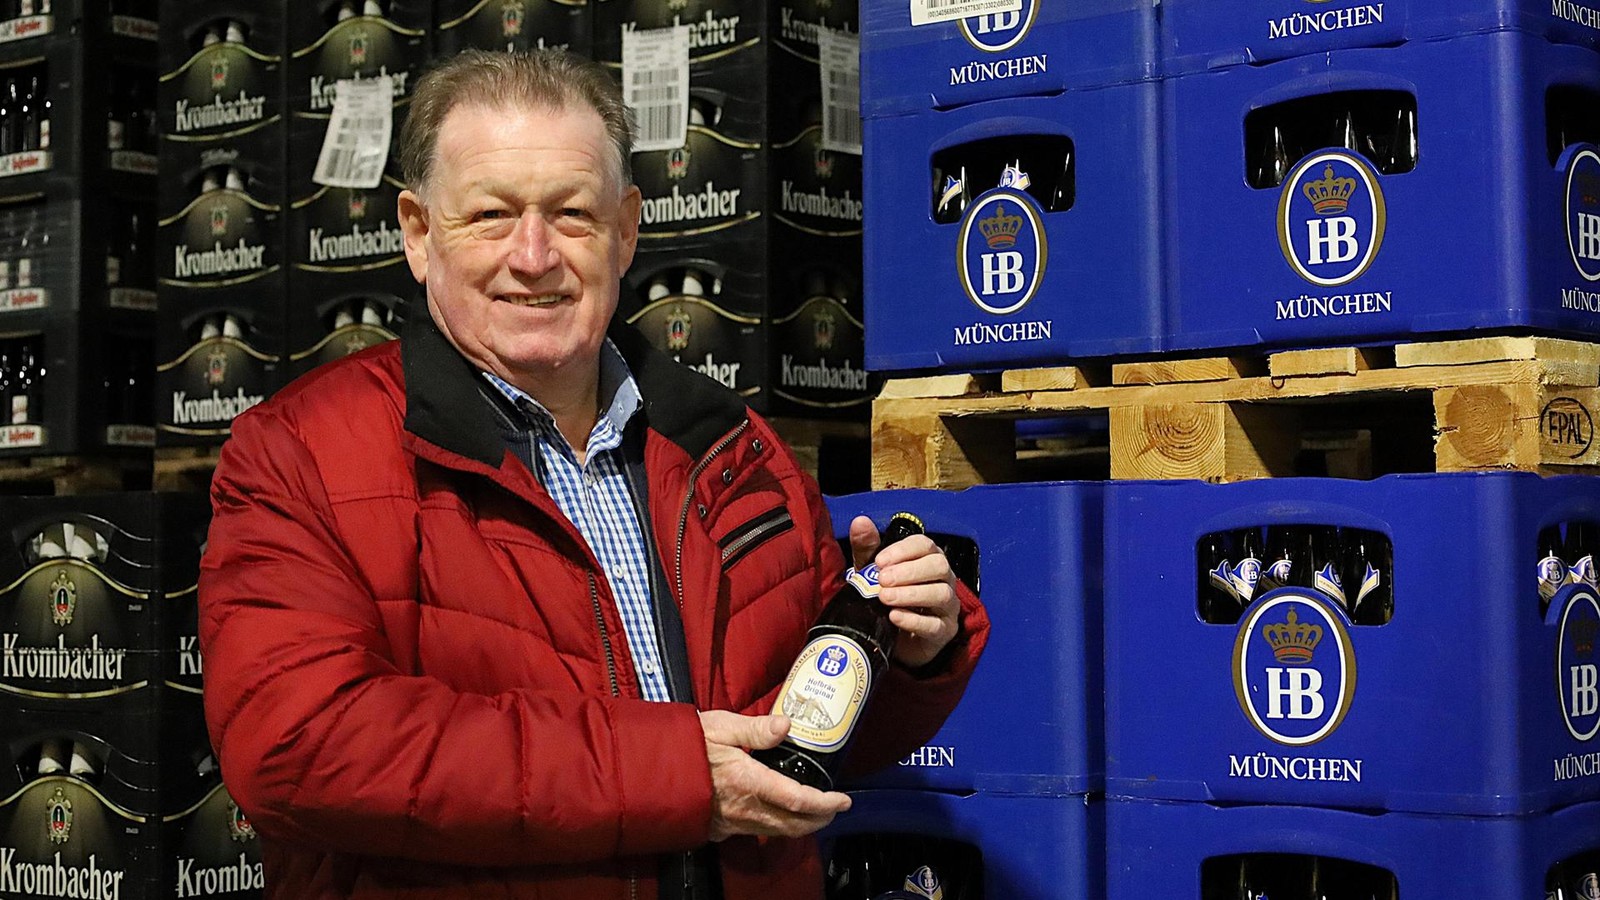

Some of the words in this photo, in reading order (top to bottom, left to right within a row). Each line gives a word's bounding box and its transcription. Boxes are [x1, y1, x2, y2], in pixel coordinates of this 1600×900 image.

[1268, 3, 1385, 39] MÜNCHEN
[950, 54, 1048, 86] MÜNCHEN
[175, 90, 266, 132] Krombacher
[639, 181, 740, 225] ombacher
[782, 180, 863, 221] Krombache
[175, 237, 266, 278] Krombacher
[1306, 216, 1359, 265] HB
[981, 251, 1025, 296] HB
[1275, 291, 1393, 320] MÜNCHEN
[954, 320, 1053, 346] MÜNCHEN
[782, 354, 870, 390] Krombacher
[2, 632, 126, 680] Krombacher
[819, 657, 841, 675] HB
[804, 684, 834, 701] Original
[1265, 667, 1326, 719] HB
[1570, 664, 1599, 717] HB
[1229, 751, 1363, 783] MÜNCHEN
[1554, 753, 1600, 781] MÜNCH
[0, 847, 124, 900] Krombacher
[178, 852, 265, 898] Kromba
